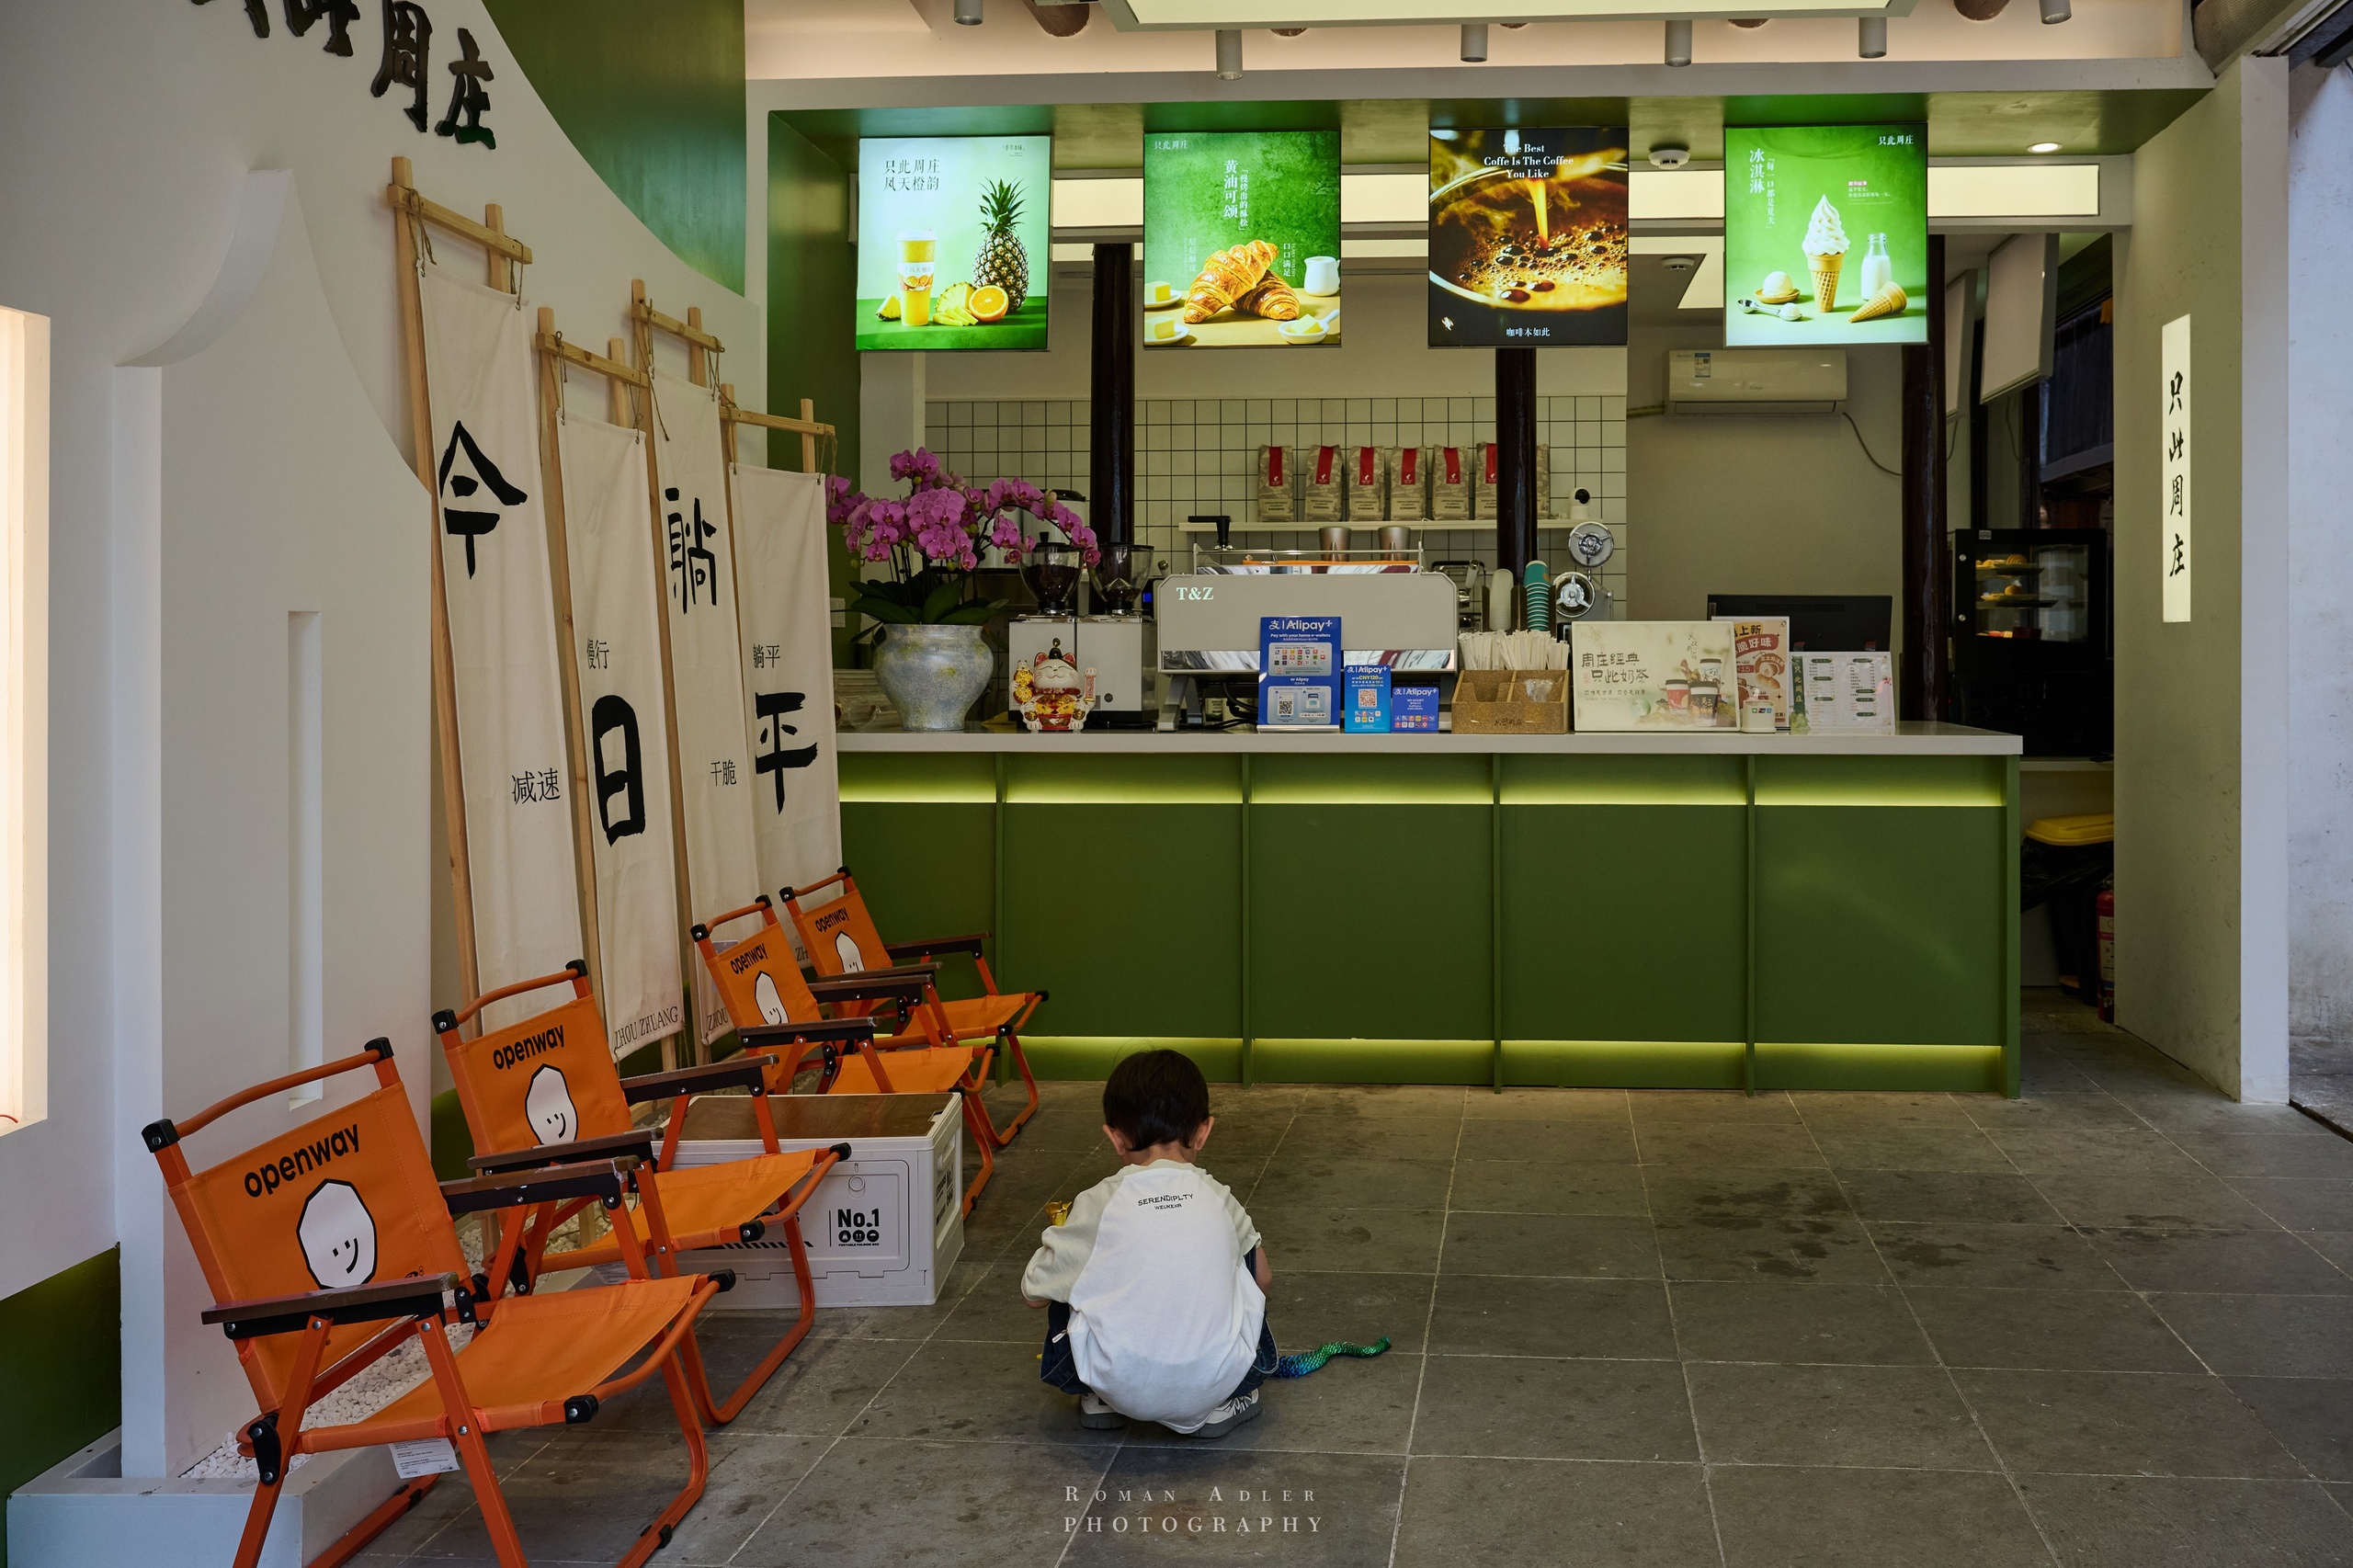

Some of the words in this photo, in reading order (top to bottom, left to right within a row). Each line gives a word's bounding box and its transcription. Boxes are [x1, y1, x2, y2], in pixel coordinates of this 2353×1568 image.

[1154, 140, 1188, 150] 只此周庄
[1524, 143, 1545, 153] Best
[1878, 135, 1914, 146] 只此周庄
[882, 158, 941, 175] 只此周庄
[1483, 156, 1509, 165] Coffe
[1512, 156, 1521, 165] Is
[1522, 156, 1541, 165] The
[1543, 155, 1574, 165] Coffee
[1749, 148, 1766, 194] 冰淇淋
[1506, 169, 1525, 178] You
[1528, 169, 1550, 178] Like
[1223, 159, 1238, 219] 黄油可颂
[1506, 327, 1551, 337] 咖啡本如此
[2168, 370, 2186, 577] 只此周庄
[665, 487, 717, 615] 躺
[1176, 586, 1214, 601] T&Z
[586, 638, 610, 670] 慢行
[753, 643, 780, 669] 躺平
[1734, 637, 1772, 655] 脆好味
[1591, 668, 1650, 685] 只此奶茶
[755, 692, 818, 815] 平
[591, 694, 646, 847] 日
[710, 759, 737, 788] 干脆
[511, 767, 562, 805] 减速
[815, 907, 850, 933] openway
[730, 943, 768, 974] openway
[795, 946, 809, 961] ZH
[614, 1022, 638, 1051] ZHOU
[639, 1006, 678, 1037] ZHUANG
[706, 1007, 729, 1032] ZHOU
[493, 1025, 564, 1070] openway
[244, 1123, 359, 1198] openway
[837, 1208, 880, 1228] No.1
